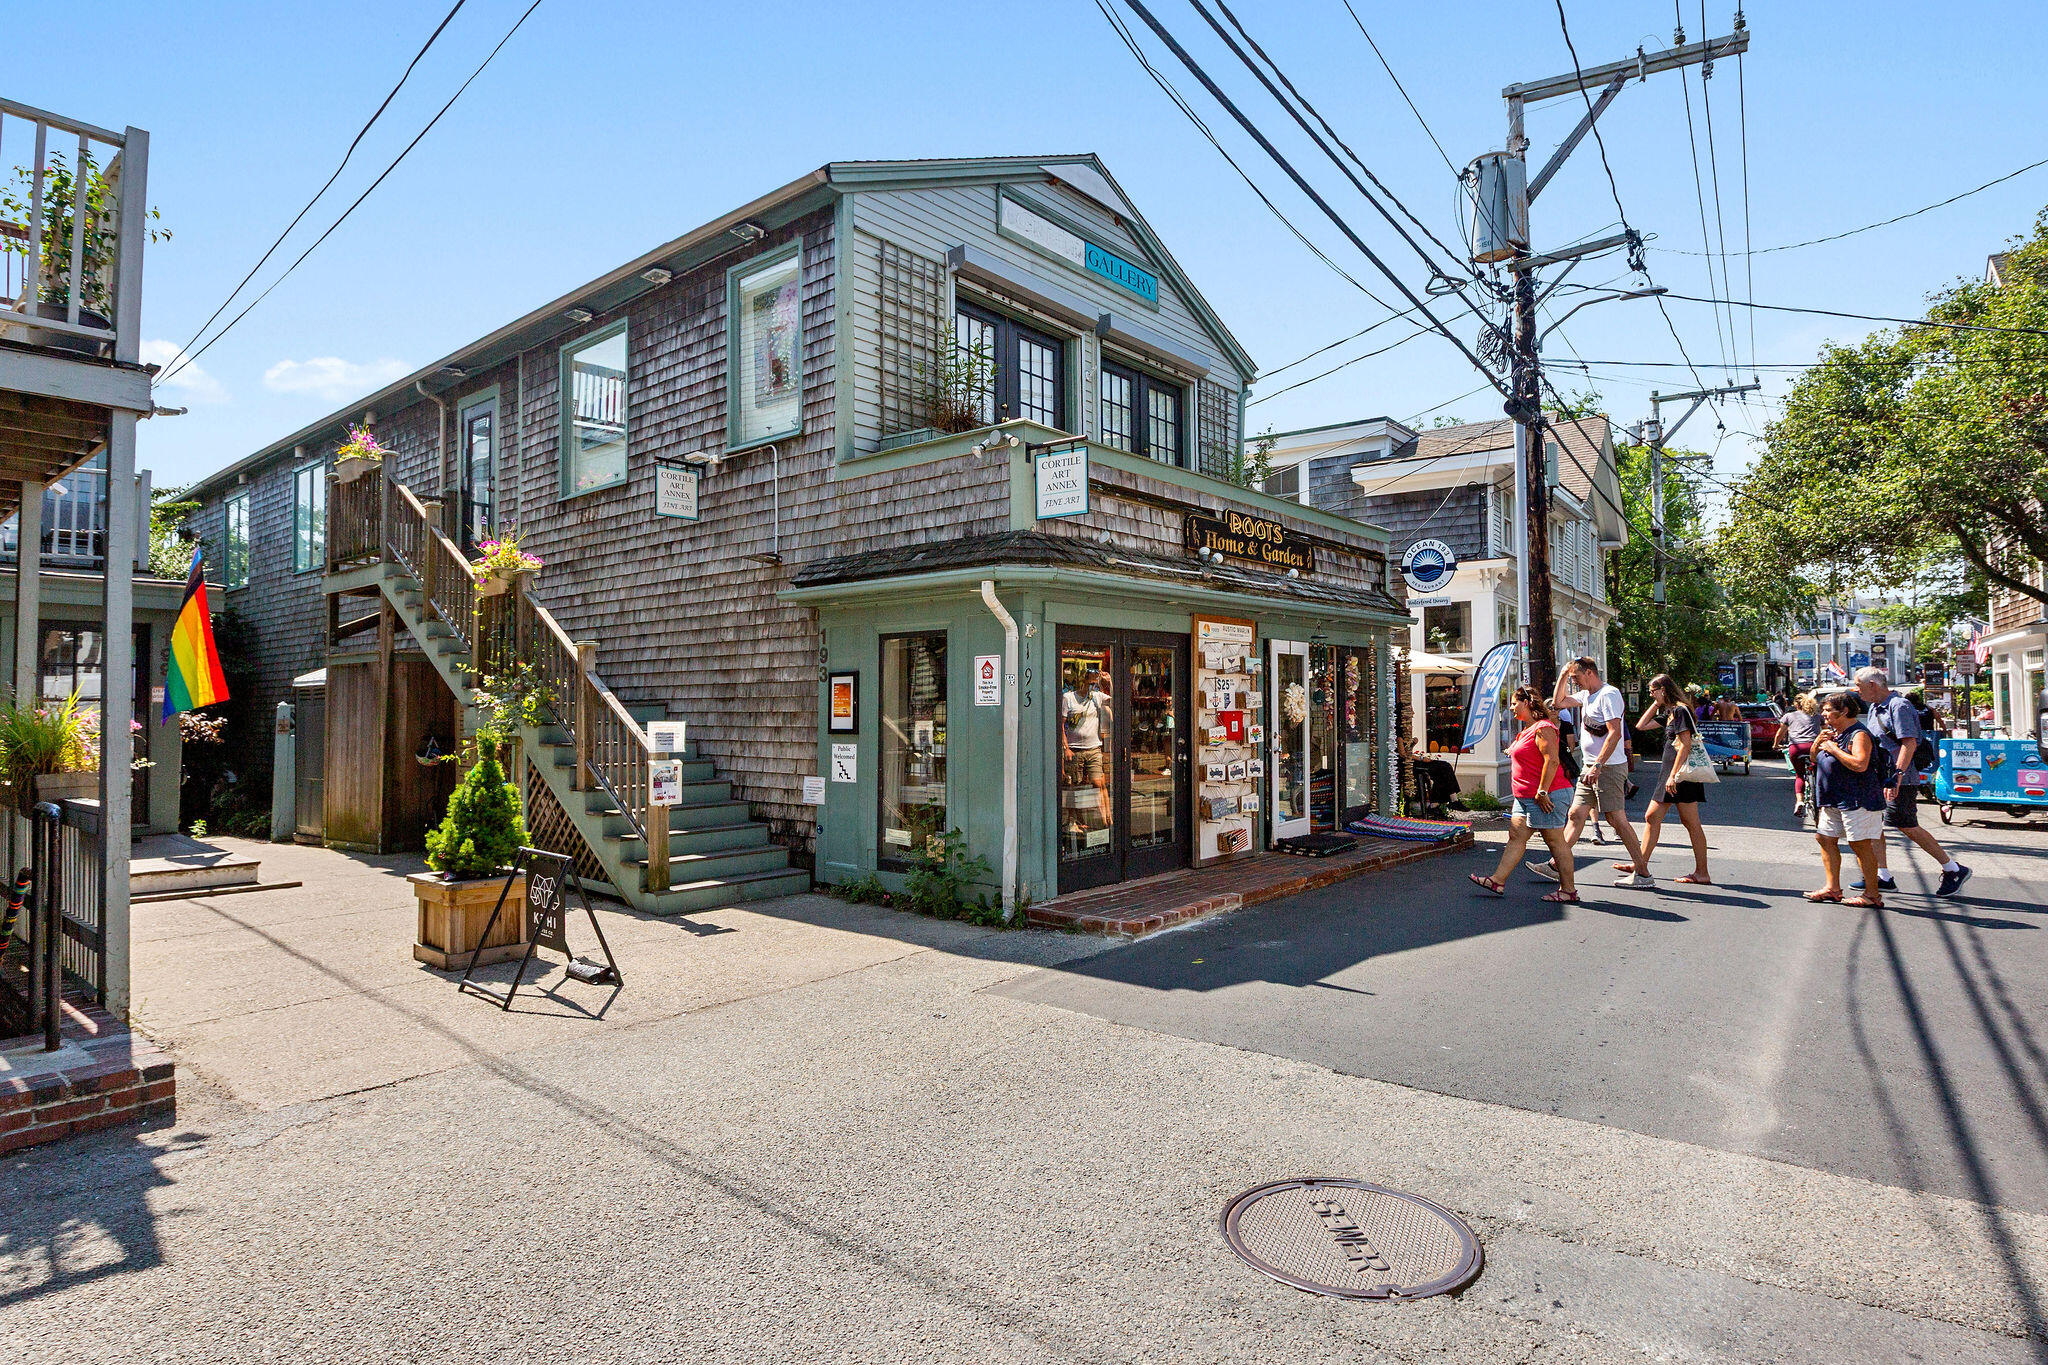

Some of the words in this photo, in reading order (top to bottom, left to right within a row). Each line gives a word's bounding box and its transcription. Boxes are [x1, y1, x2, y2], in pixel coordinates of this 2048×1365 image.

[1088, 250, 1154, 295] GALLERY
[1041, 456, 1082, 470] CORTILE
[661, 472, 694, 484] CORTILE
[1052, 469, 1072, 480] ART
[670, 482, 685, 491] ART
[1045, 479, 1078, 492] ANNEX
[664, 490, 690, 500] ANNEX
[663, 502, 678, 510] FINE
[1043, 498, 1063, 509] FINE
[1064, 496, 1081, 505] ART
[1229, 512, 1283, 544] ROOTS
[1204, 529, 1245, 550] Home
[1247, 541, 1259, 556] &
[1262, 543, 1304, 567] Garden
[1407, 540, 1435, 559] OCEAN
[1437, 544, 1450, 556] 193
[1411, 579, 1445, 589] RESTAURANT
[819, 628, 828, 682] 193
[1023, 642, 1033, 708] 193
[1216, 679, 1230, 690] $25
[1469, 645, 1509, 737] OPEN
[1629, 683, 1639, 691] 15
[1953, 742, 1975, 750] HELPING
[1989, 743, 2005, 751] HAND
[1309, 1199, 1390, 1272] SEWER
